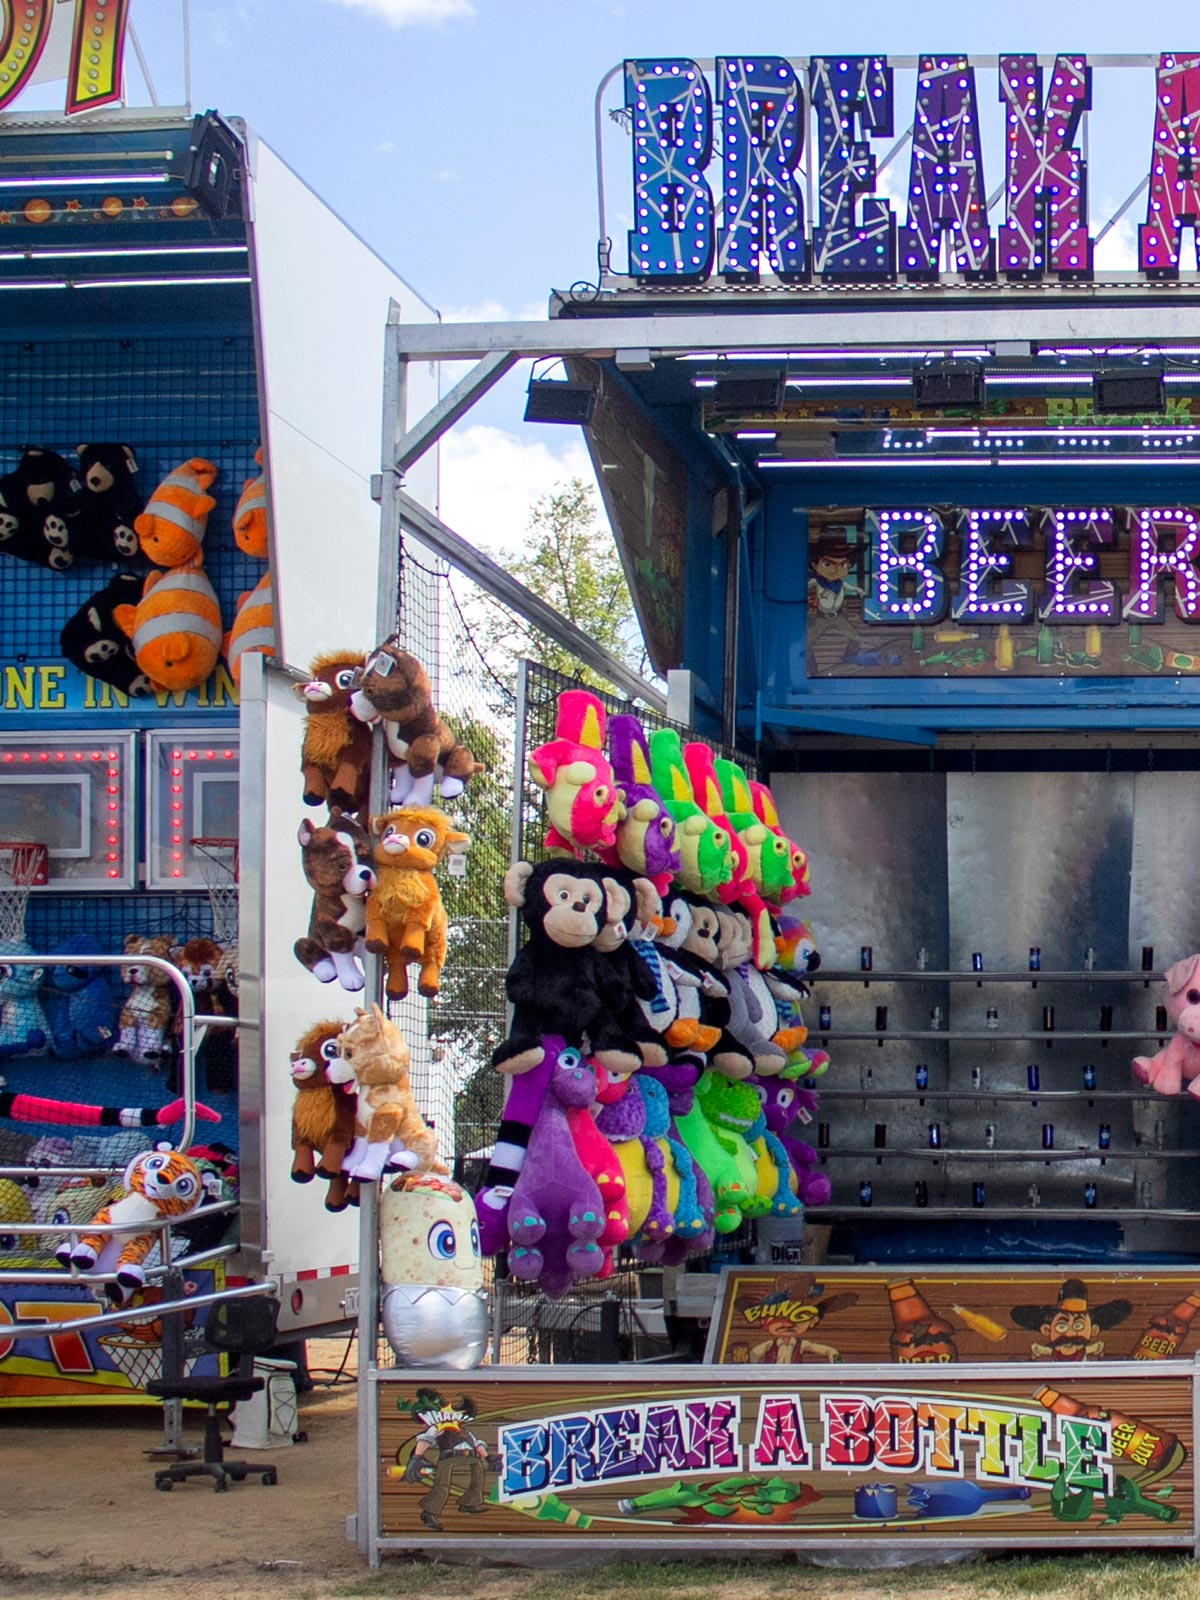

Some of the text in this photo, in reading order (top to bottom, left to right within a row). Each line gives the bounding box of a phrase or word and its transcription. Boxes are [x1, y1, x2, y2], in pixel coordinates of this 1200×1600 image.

[624, 54, 1094, 282] BREAK
[1046, 398, 1192, 425] BRK
[1141, 1336, 1177, 1355] BEER
[500, 1396, 1110, 1498] BREAK A BOTTLE
[1111, 1423, 1136, 1457] BEER
[1130, 1433, 1160, 1466] BUST
